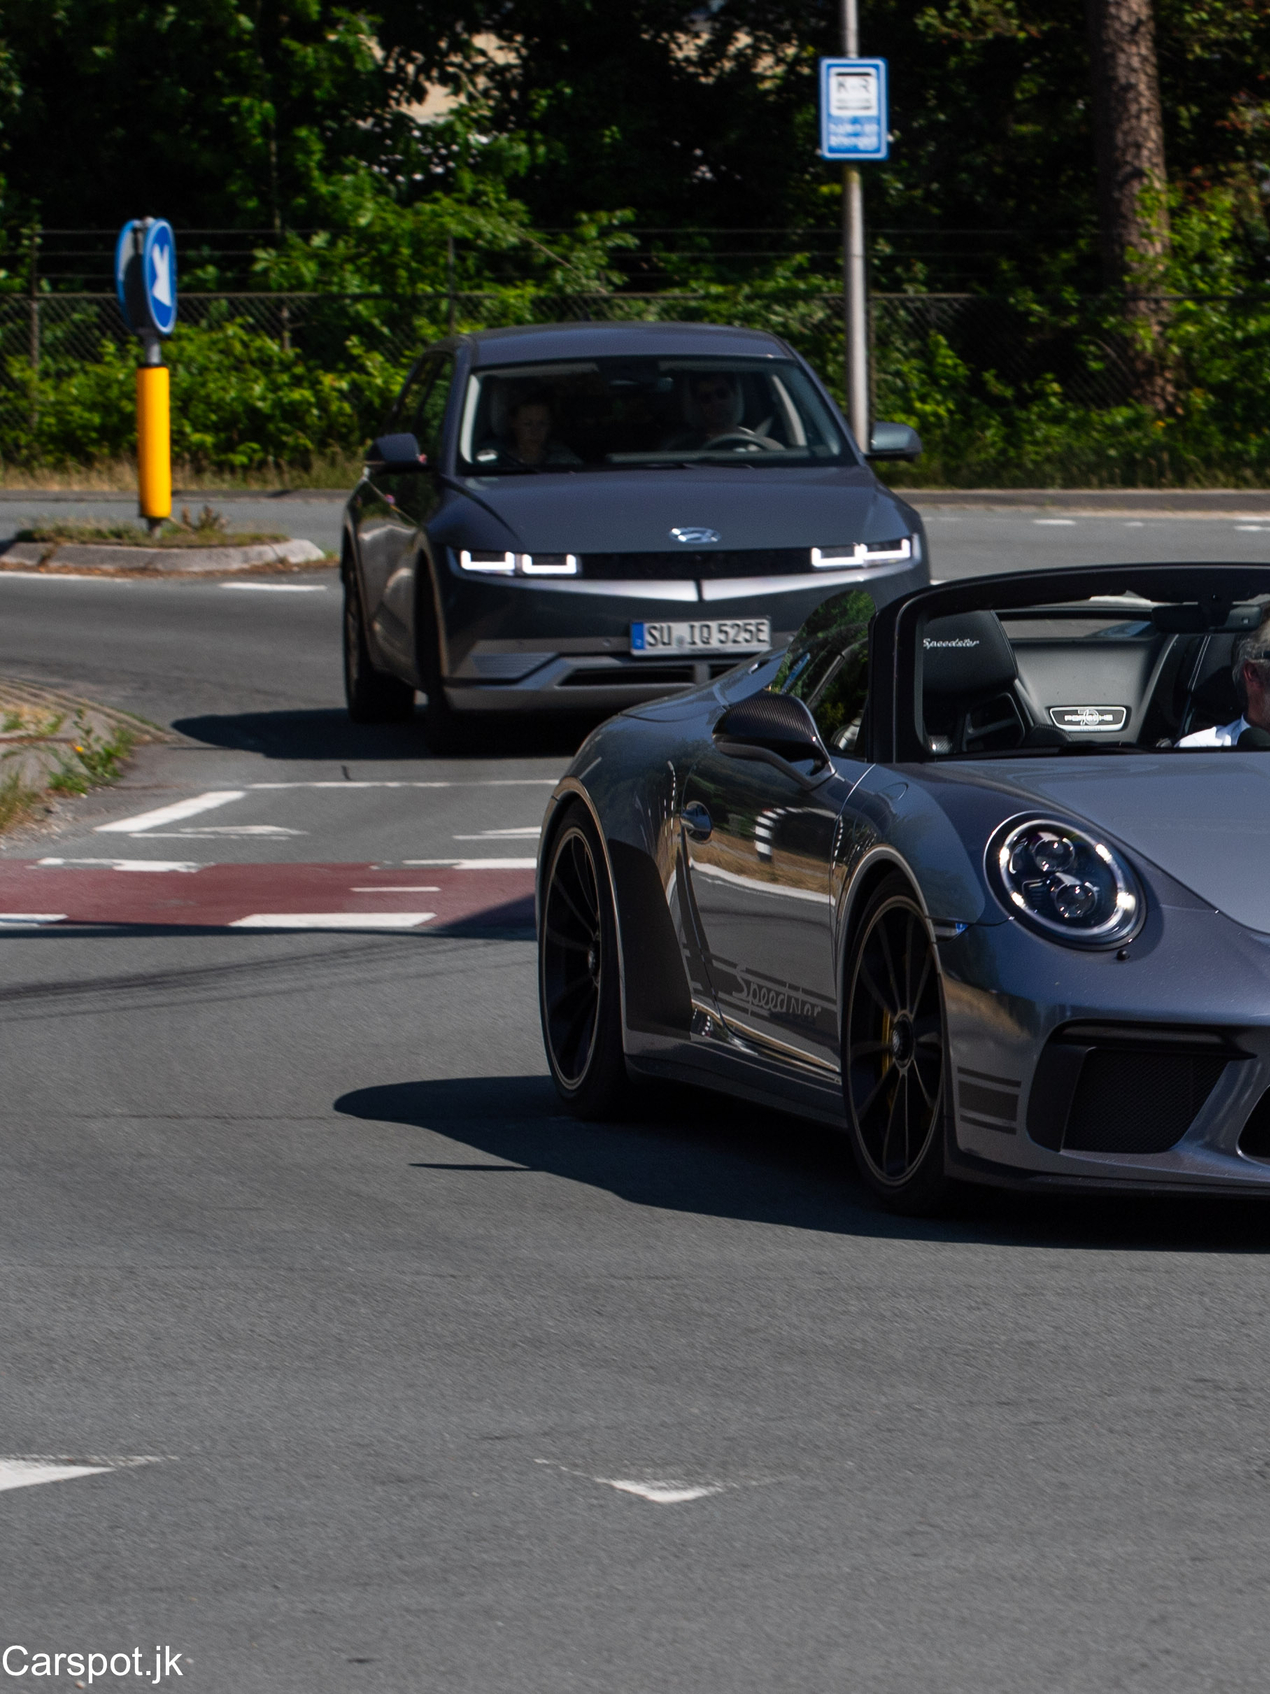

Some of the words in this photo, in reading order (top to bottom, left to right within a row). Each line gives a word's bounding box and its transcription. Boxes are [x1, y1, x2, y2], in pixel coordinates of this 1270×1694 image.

[647, 625, 672, 647] SU
[688, 624, 712, 645] IQ
[717, 622, 769, 645] 525E
[923, 637, 980, 650] Speedster
